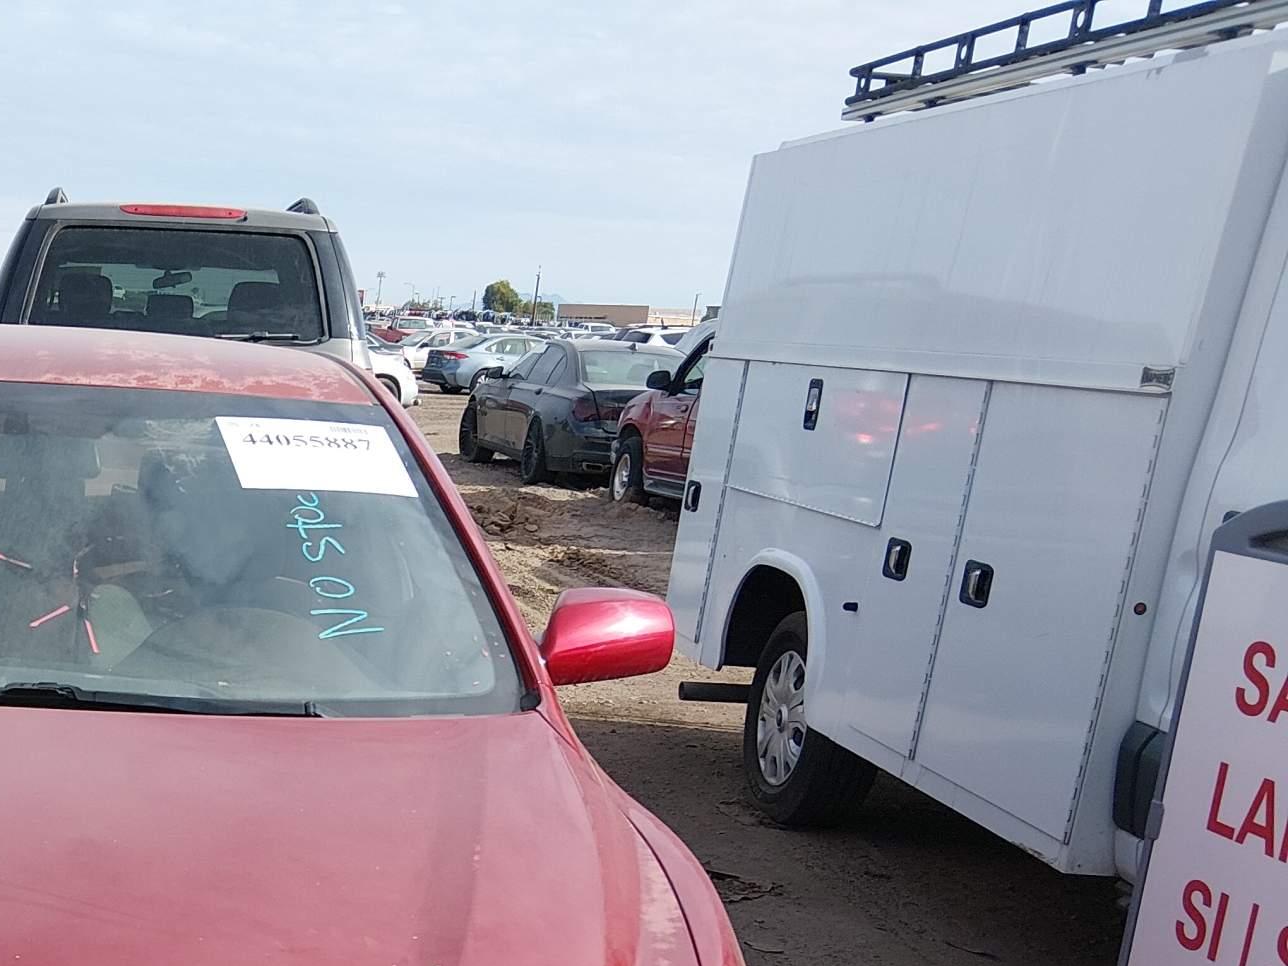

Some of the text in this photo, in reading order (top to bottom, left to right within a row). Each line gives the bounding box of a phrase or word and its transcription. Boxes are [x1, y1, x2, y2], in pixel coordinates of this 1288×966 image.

[242, 432, 371, 451] 44055887
[309, 575, 385, 639] NO
[1206, 761, 1288, 864] LA
[1175, 879, 1230, 962] SI
